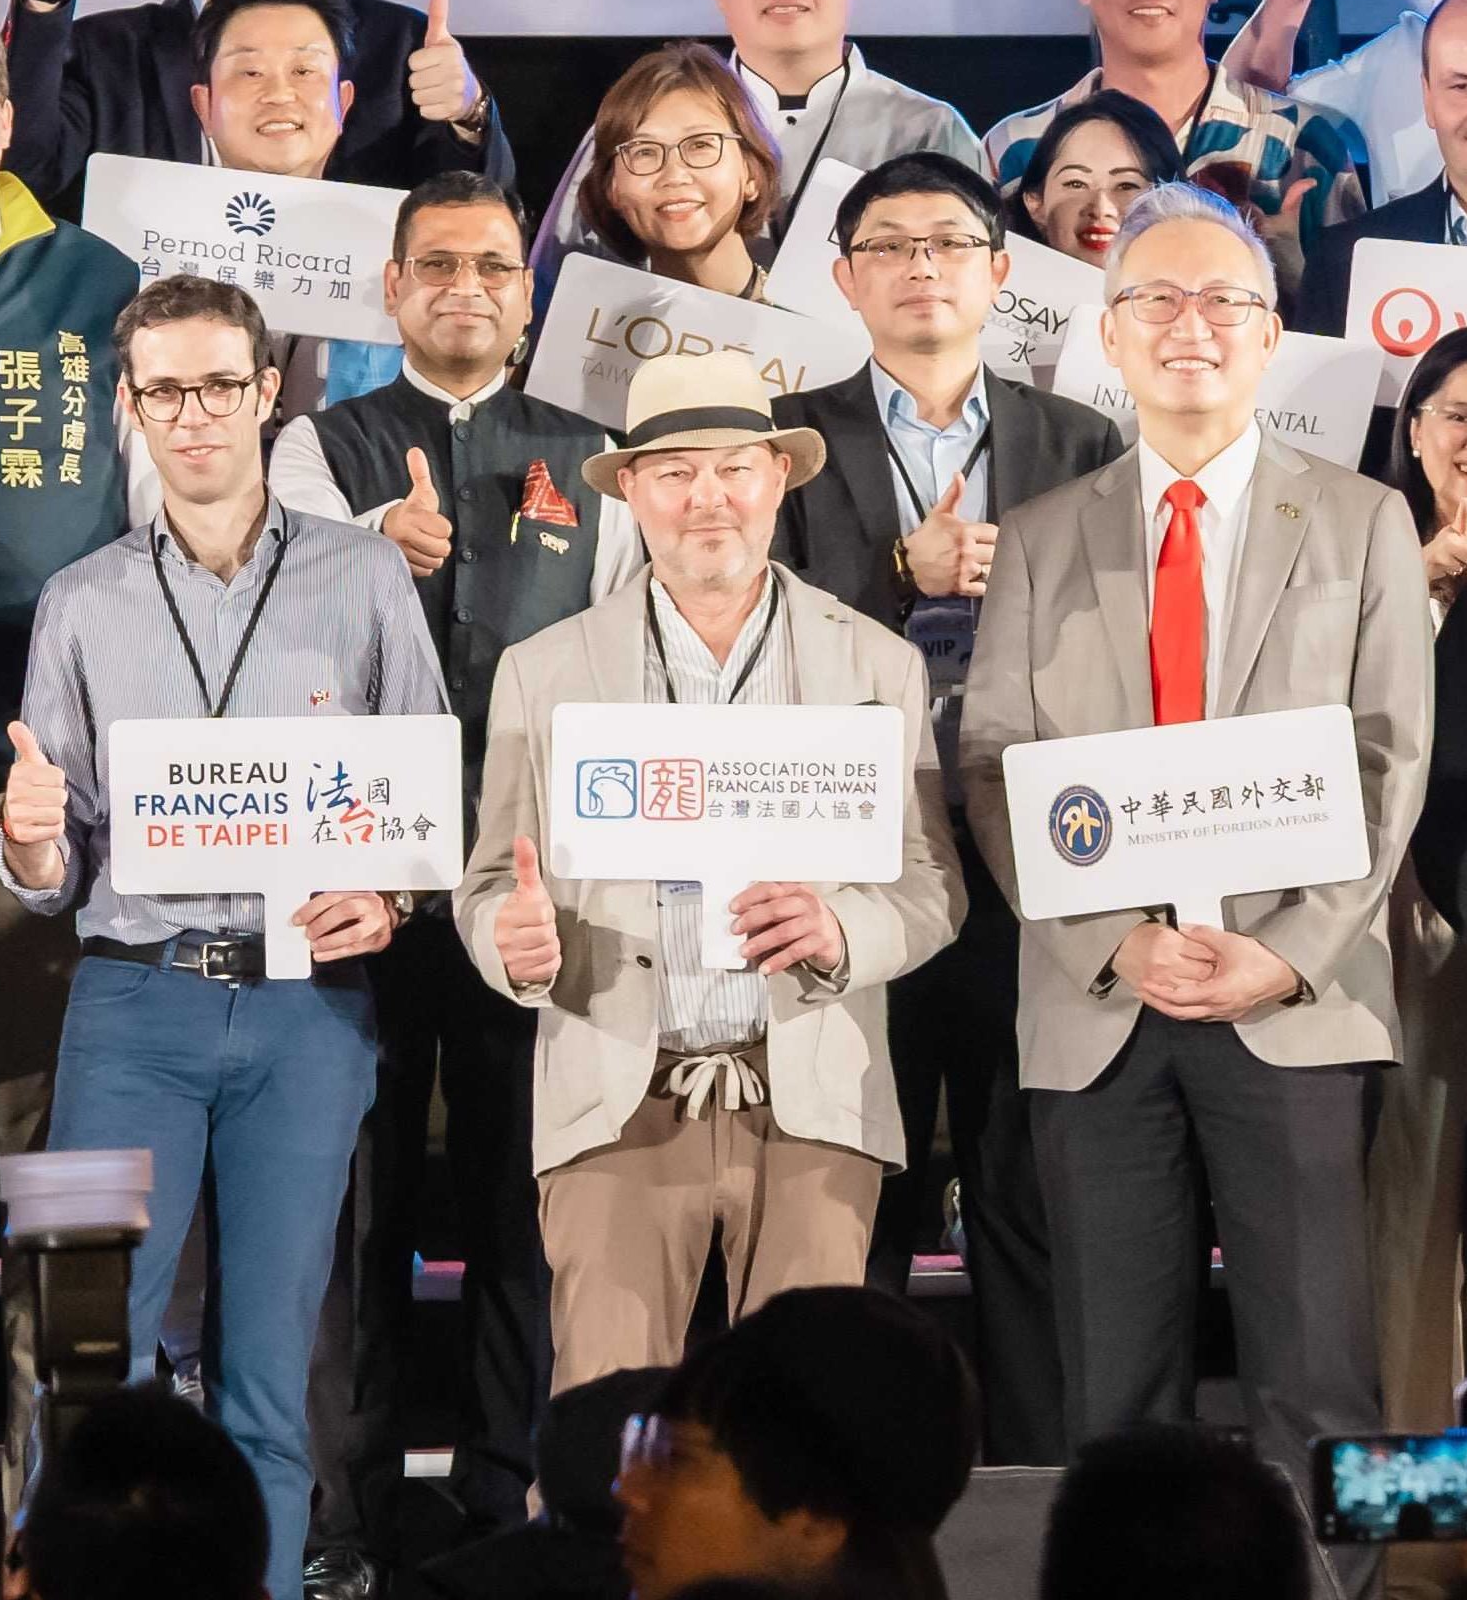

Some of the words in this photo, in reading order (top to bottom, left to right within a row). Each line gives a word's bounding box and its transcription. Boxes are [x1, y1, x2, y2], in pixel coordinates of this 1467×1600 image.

[142, 230, 245, 262] Pernod
[256, 243, 351, 275] Ricard
[993, 290, 1069, 334] OSAY
[585, 307, 807, 394] L'ORAL
[1007, 340, 1036, 365] 水
[57, 329, 91, 486] 高雄分處長
[923, 639, 956, 657] VIP
[168, 762, 288, 786] BUREAU
[707, 761, 836, 778] ASSOCIATION
[844, 763, 878, 778] DES
[790, 781, 810, 794] DE
[814, 781, 877, 794] TAIWAN
[1119, 773, 1327, 825] 中華民國外交部
[134, 792, 289, 820] FRANÇAIS
[707, 799, 877, 820] 台灣法國人協會
[147, 825, 185, 848] DE
[195, 823, 289, 848] TAIPEI
